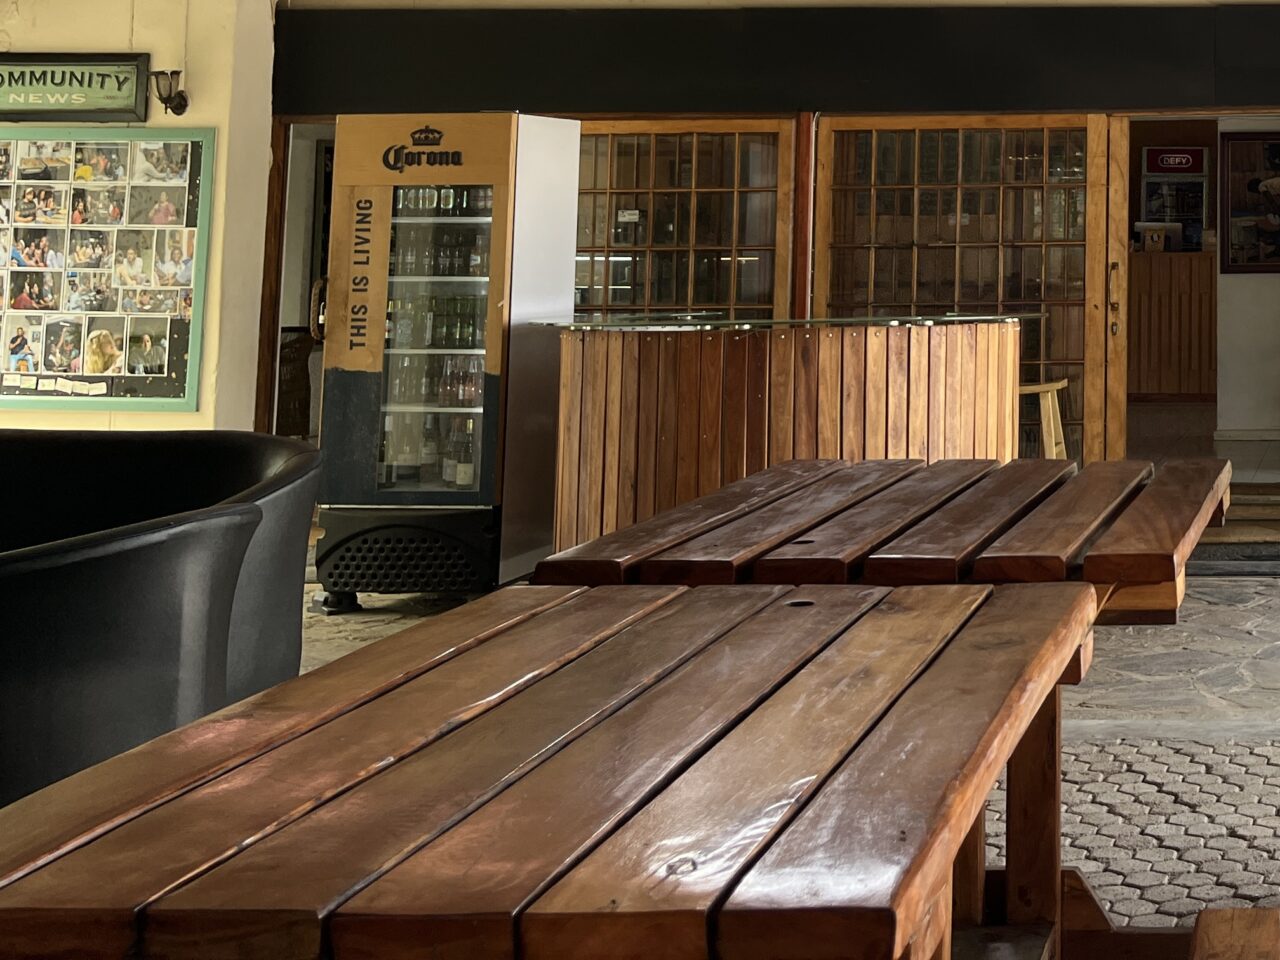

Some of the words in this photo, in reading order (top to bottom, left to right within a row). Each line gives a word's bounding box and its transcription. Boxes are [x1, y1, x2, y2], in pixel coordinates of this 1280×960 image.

[8, 92, 88, 104] NEWS
[382, 144, 464, 174] Corona
[1163, 156, 1188, 166] DEFY
[353, 198, 374, 266] LIVING
[352, 275, 370, 293] IS
[349, 304, 368, 351] THIS
